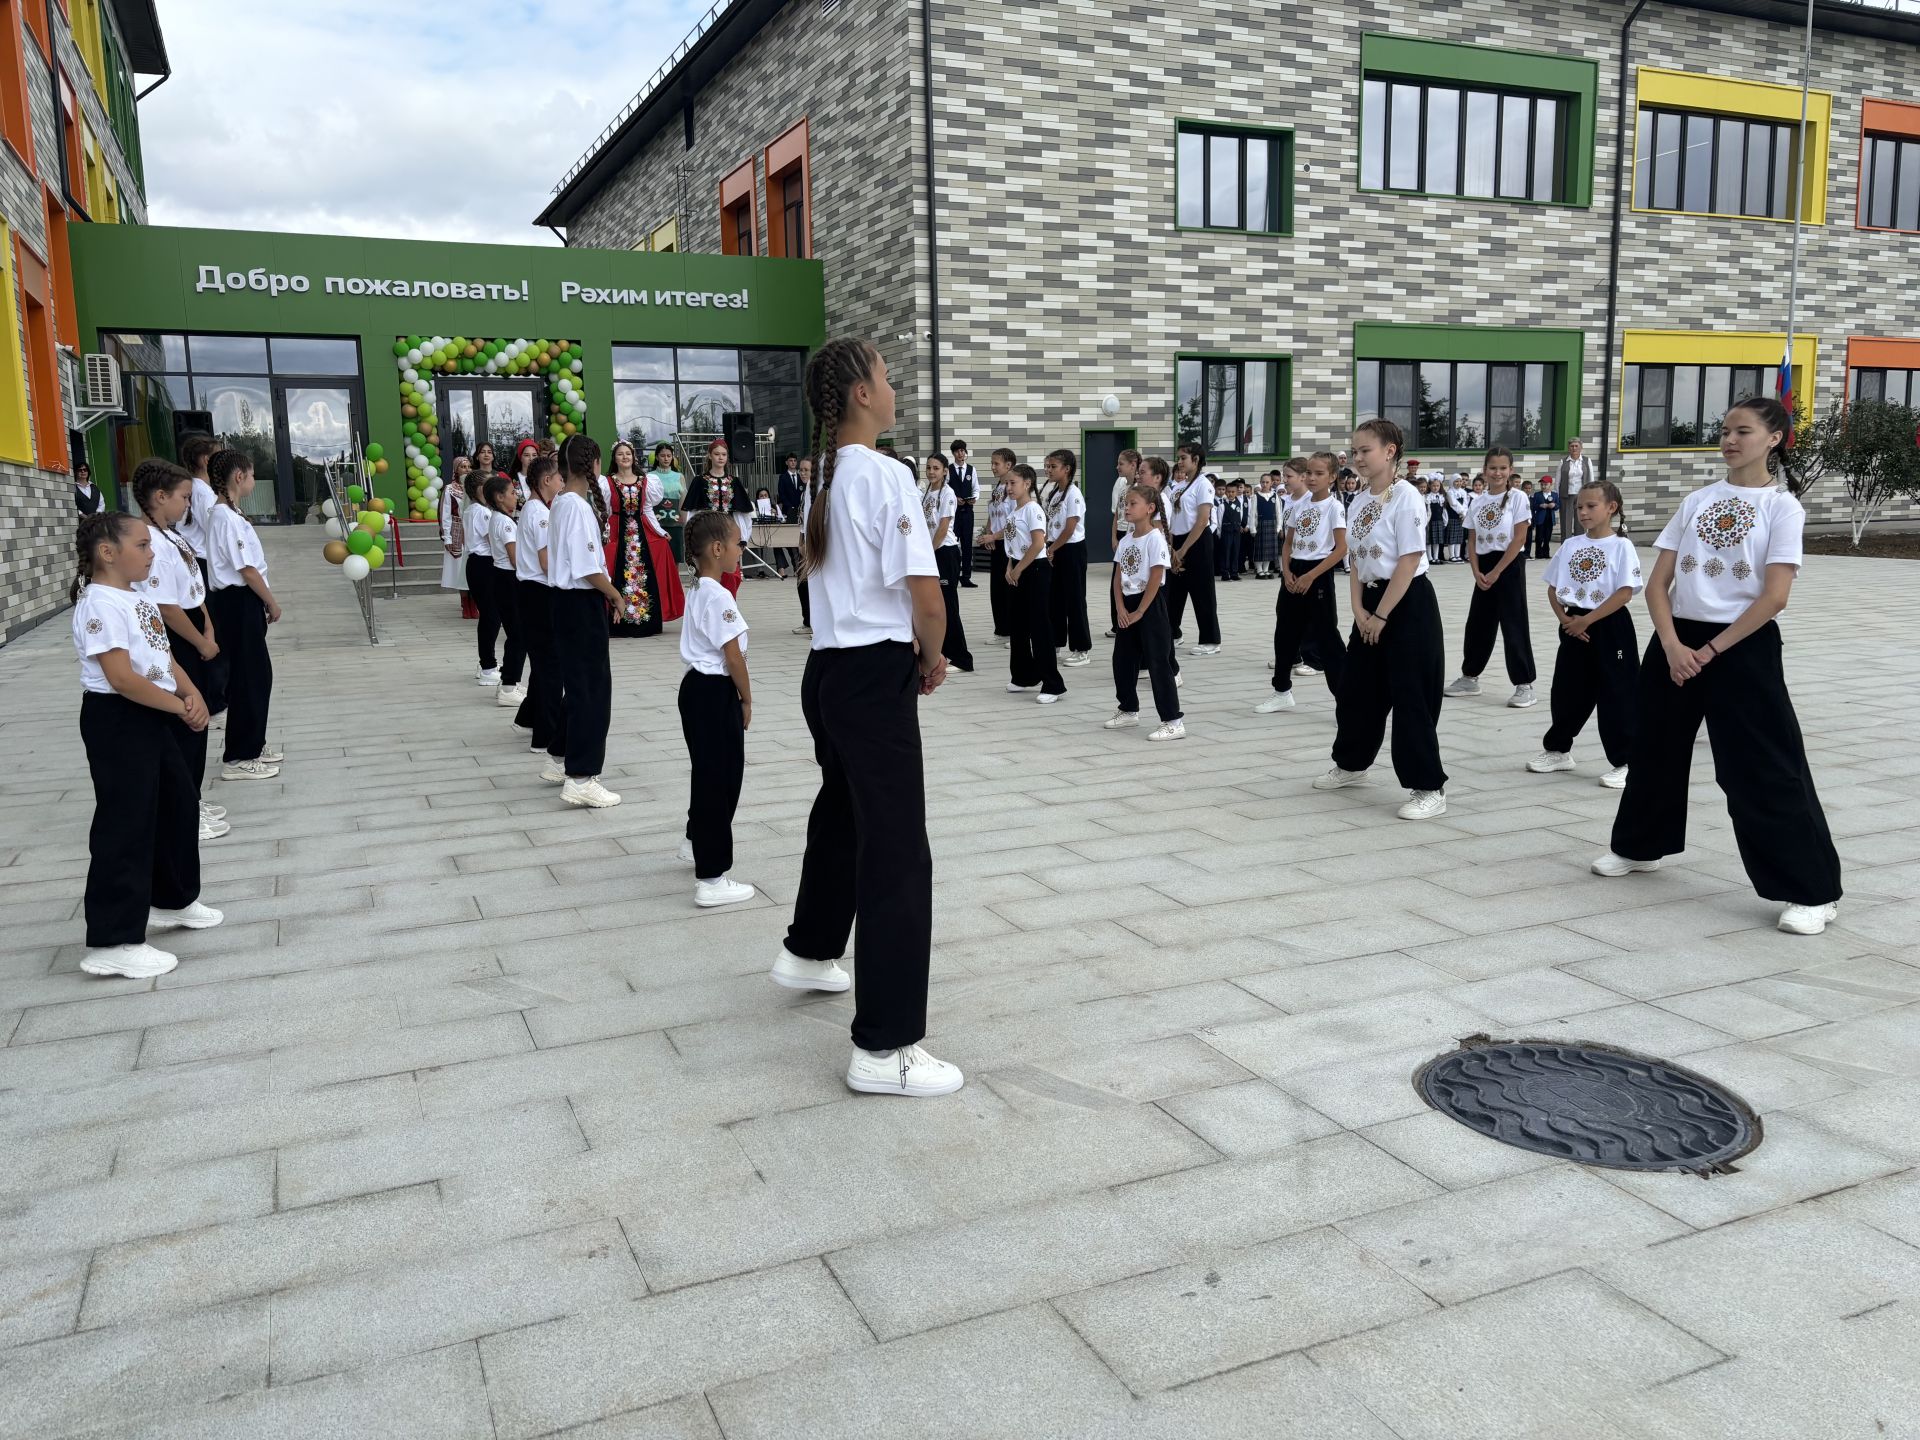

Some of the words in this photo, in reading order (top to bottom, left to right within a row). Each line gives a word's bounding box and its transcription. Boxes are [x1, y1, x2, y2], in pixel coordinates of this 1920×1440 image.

[196, 265, 310, 297] Добро
[325, 276, 529, 301] пожаловать!
[560, 281, 648, 305] Рәхим
[655, 288, 749, 309] итегез!
